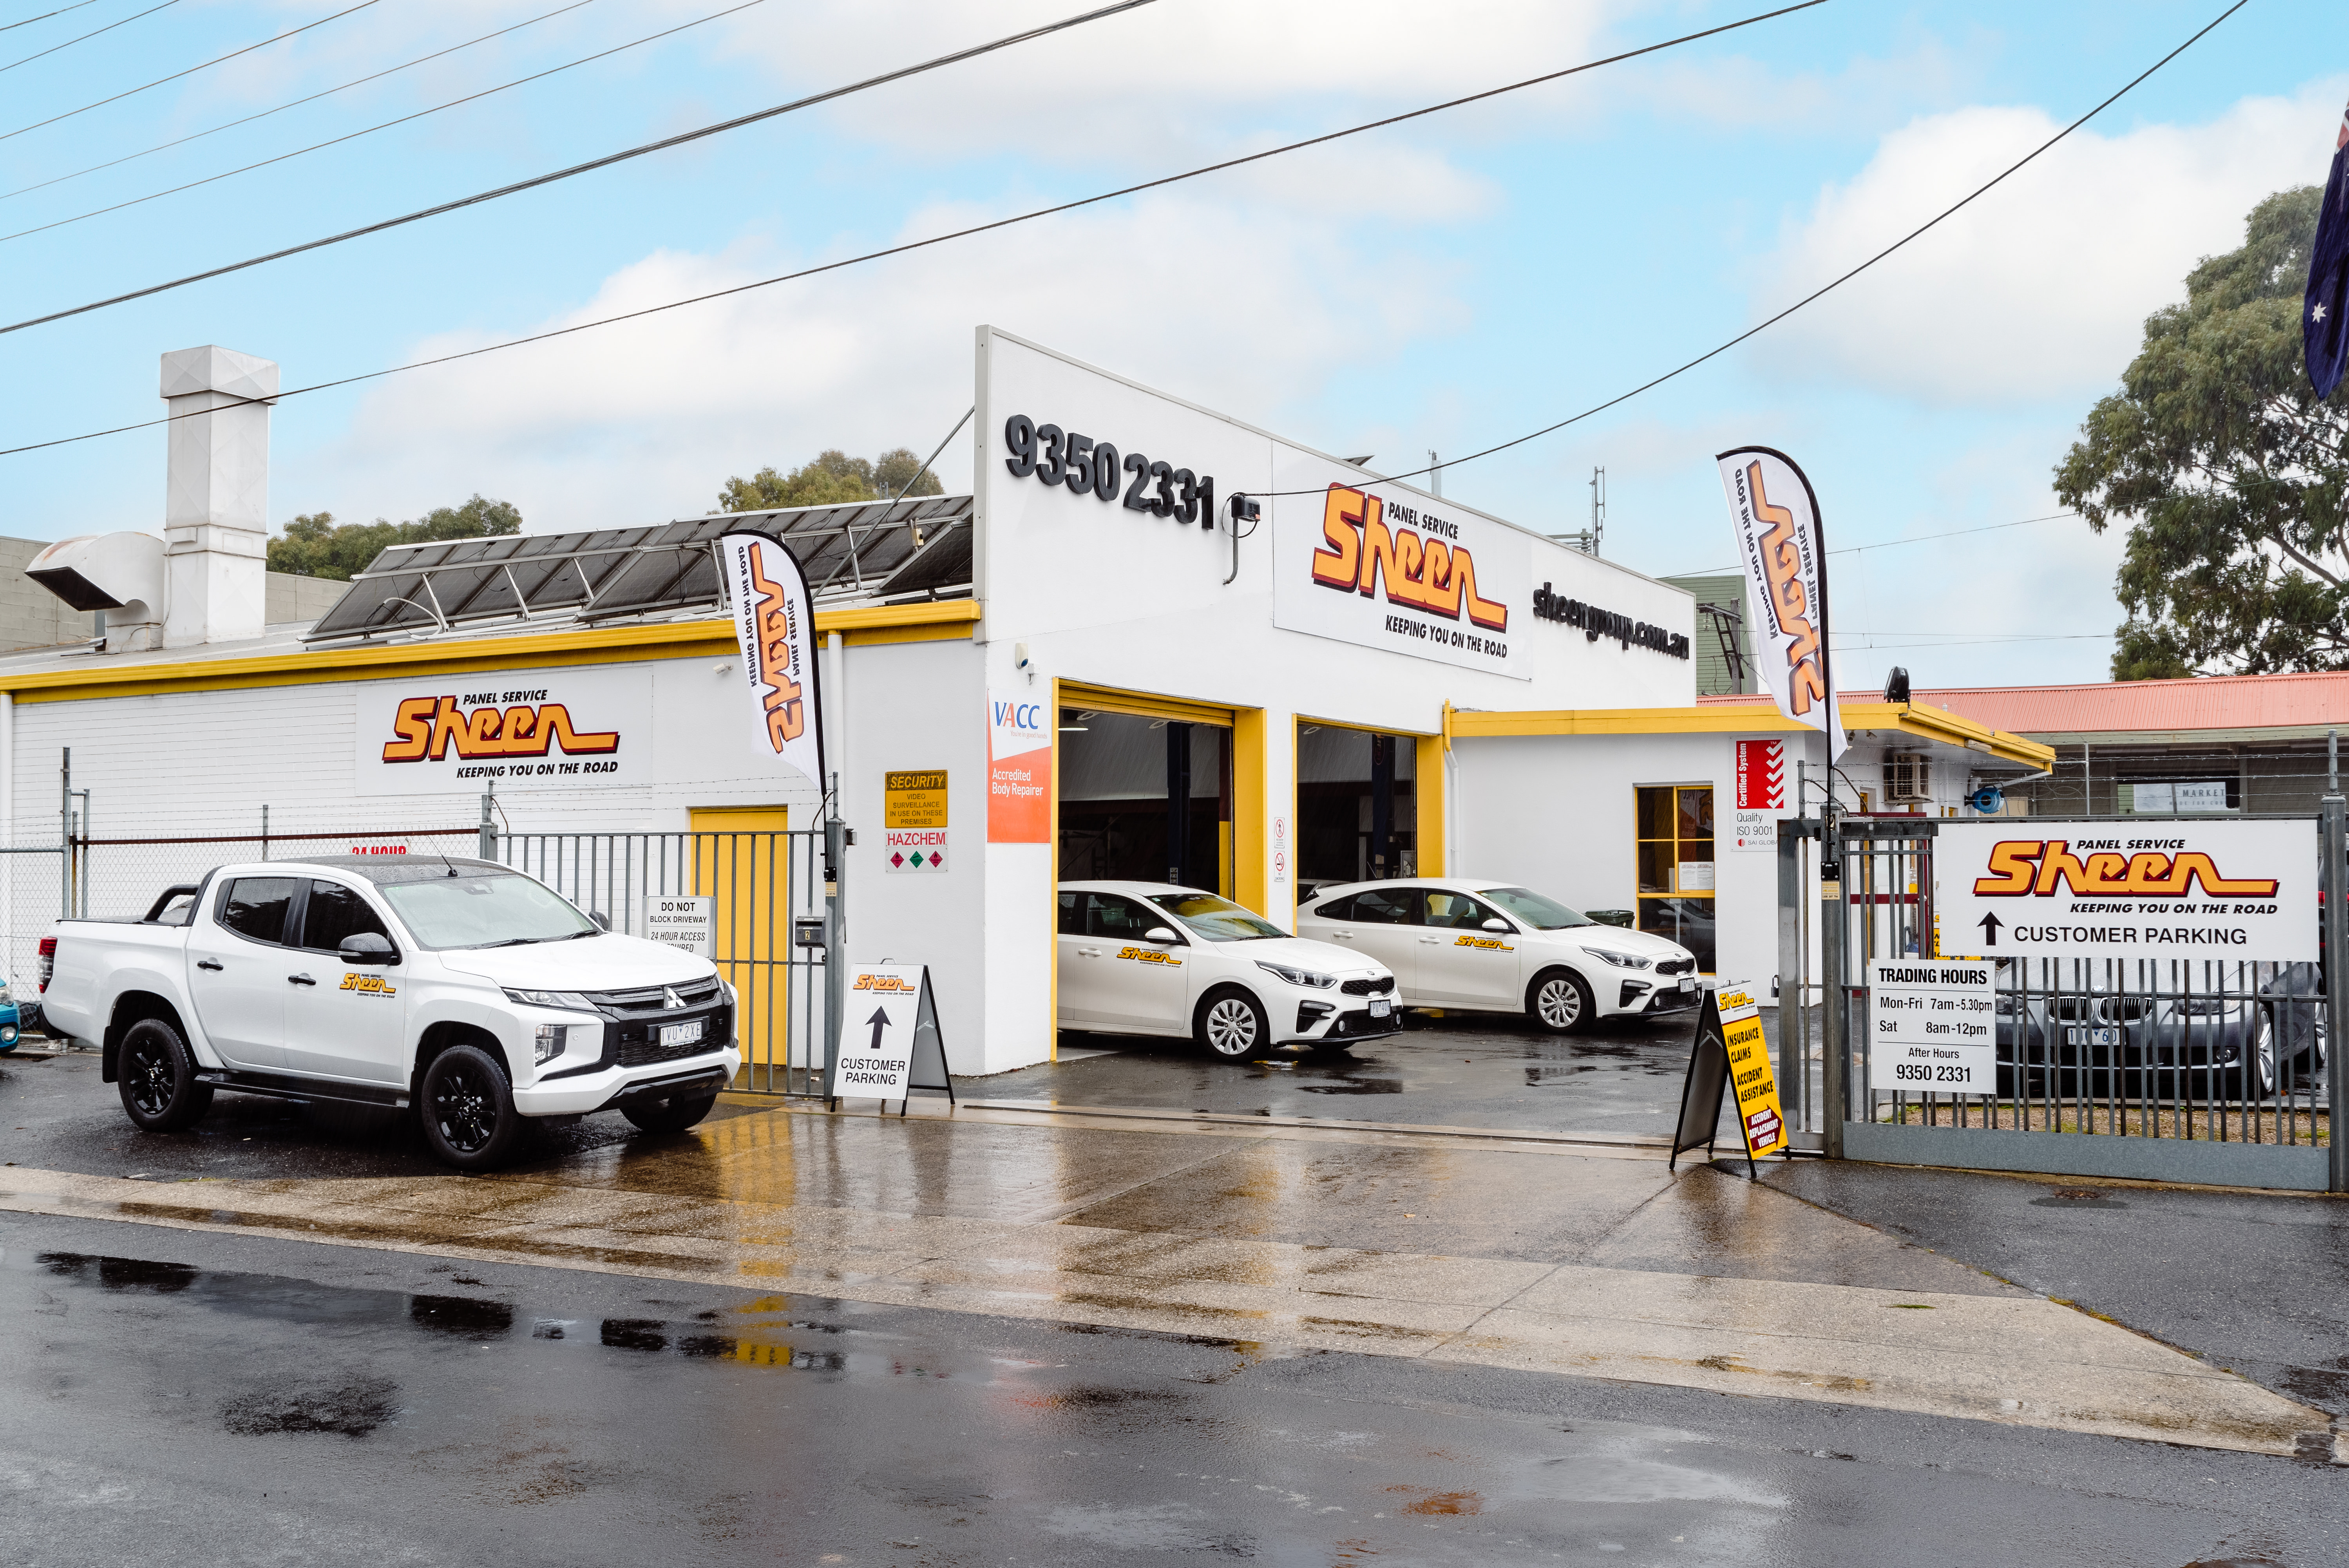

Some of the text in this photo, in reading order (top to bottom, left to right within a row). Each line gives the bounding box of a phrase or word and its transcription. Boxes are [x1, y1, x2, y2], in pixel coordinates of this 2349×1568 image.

[1005, 414, 1214, 530] 9350 2331
[1388, 501, 1458, 540] PANEL SERVICE
[1312, 481, 1507, 633] Sheen
[1385, 615, 1507, 658] KEEPING YOU ON THE ROAD
[463, 689, 548, 705] PANEL SERVICE
[995, 701, 1040, 729] VACC
[382, 695, 620, 763] Sheen
[456, 761, 618, 778] KEEPING YOU ON THE ROAD
[992, 768, 1031, 781] Accredited
[1739, 743, 1748, 807] Certified System
[890, 775, 944, 788] SECURITY
[992, 781, 1043, 798] Body Repairer
[1737, 813, 1763, 824] Quality
[888, 832, 945, 846] HAZCHEM
[1737, 826, 1772, 836] ISO 9001
[2076, 839, 2186, 849] PANEL SERVICE
[1973, 840, 2280, 898] Sheen
[661, 902, 695, 912] DO NOT
[2070, 903, 2278, 914] KEEPING YOU ON THE ROAD
[651, 931, 706, 941] 24 HOUR ACCESS
[1454, 935, 1514, 950] Sheen
[2014, 926, 2247, 944] CUSTOMER PARKING
[1117, 946, 1182, 965] Sheen
[339, 973, 396, 993] Sheen
[853, 974, 915, 991] Sheen
[1878, 968, 1987, 984] TRADING HOURS
[1719, 992, 1754, 1012] Sheen
[1880, 997, 1922, 1009] Mon-Fri
[662, 1024, 700, 1042] 1VU 2XE
[1880, 1020, 1897, 1032] Sat
[1727, 1027, 1759, 1047] INSURANCE
[1730, 1046, 1751, 1064] CLAIMS
[1908, 1047, 1959, 1058] After Hours
[841, 1058, 905, 1071] CUSTOMER
[1897, 1064, 1970, 1082] 9350 2331
[845, 1072, 896, 1085] PARKING
[1737, 1067, 1763, 1087] ACCIDENT
[1741, 1080, 1774, 1103] ASSISTANCE
[1751, 1109, 1772, 1125] ACCIDENT
[1749, 1119, 1779, 1139] REPLACEMENT
[1757, 1132, 1775, 1148] VEHICLE
